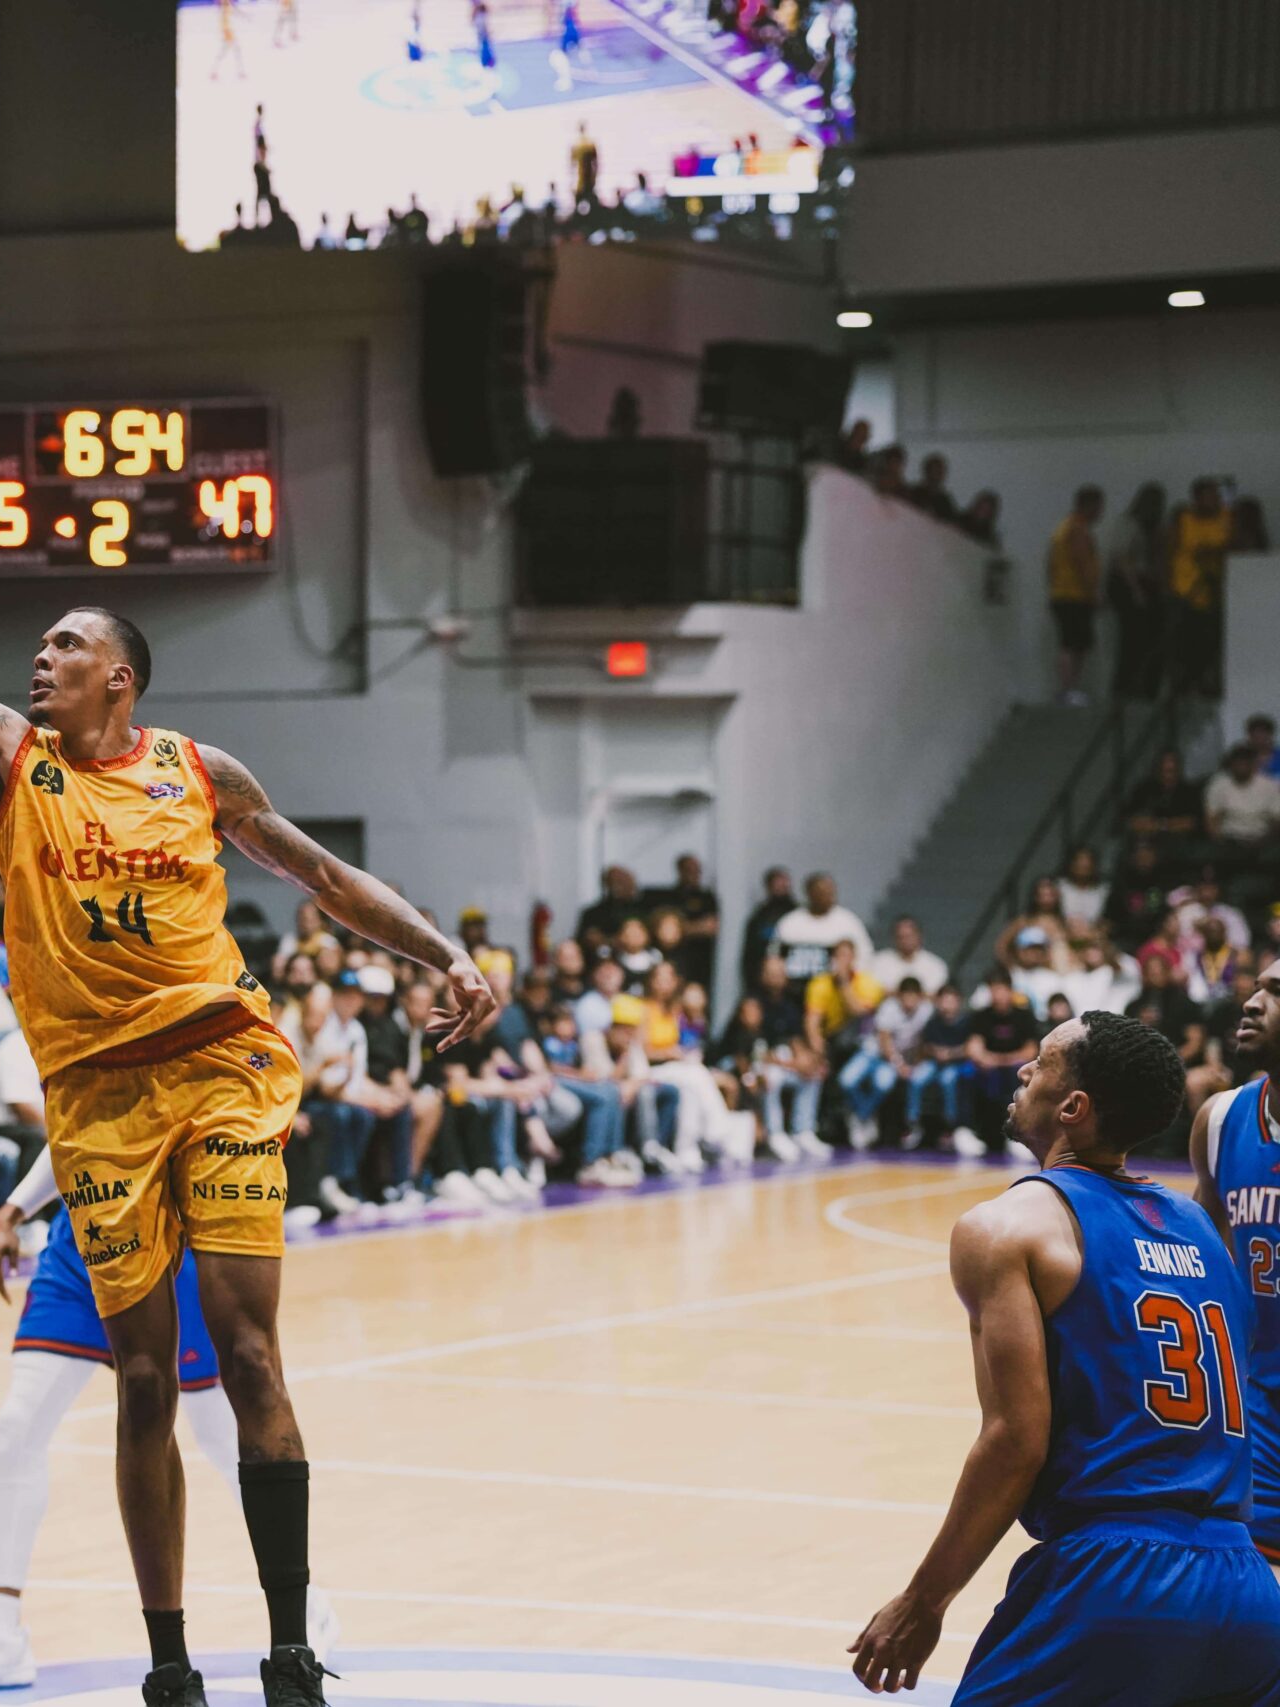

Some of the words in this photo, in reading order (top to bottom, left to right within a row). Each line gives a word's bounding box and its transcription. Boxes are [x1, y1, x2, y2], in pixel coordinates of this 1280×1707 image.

[90, 500, 129, 567] 2
[199, 475, 272, 538] 47
[85, 821, 116, 846] EL
[80, 891, 154, 946] 14
[74, 1171, 94, 1188] LA
[1134, 1238, 1206, 1279] JENKINS
[1133, 1289, 1246, 1438] 31
